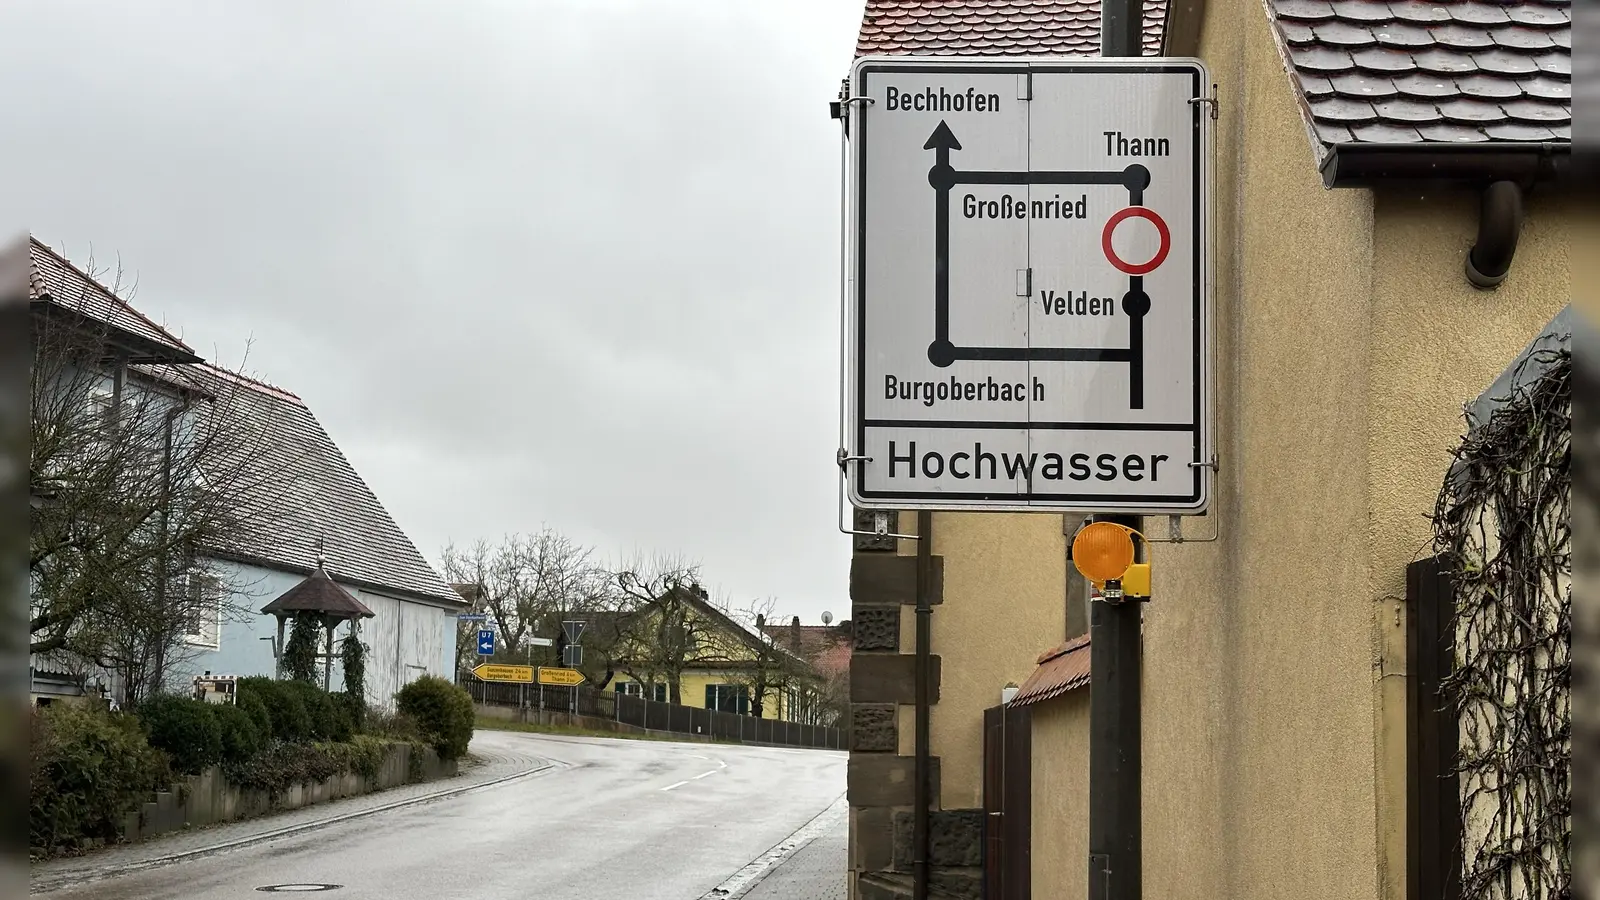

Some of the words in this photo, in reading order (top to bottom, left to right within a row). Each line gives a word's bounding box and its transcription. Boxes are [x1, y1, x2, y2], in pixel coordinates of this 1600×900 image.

[887, 87, 999, 111] Bechhofen
[1104, 132, 1169, 156] Thann
[964, 194, 1087, 219] Großenried
[1041, 291, 1113, 315] Velden
[885, 375, 1045, 407] Burgoberbach
[889, 441, 1169, 482] Hochwasser
